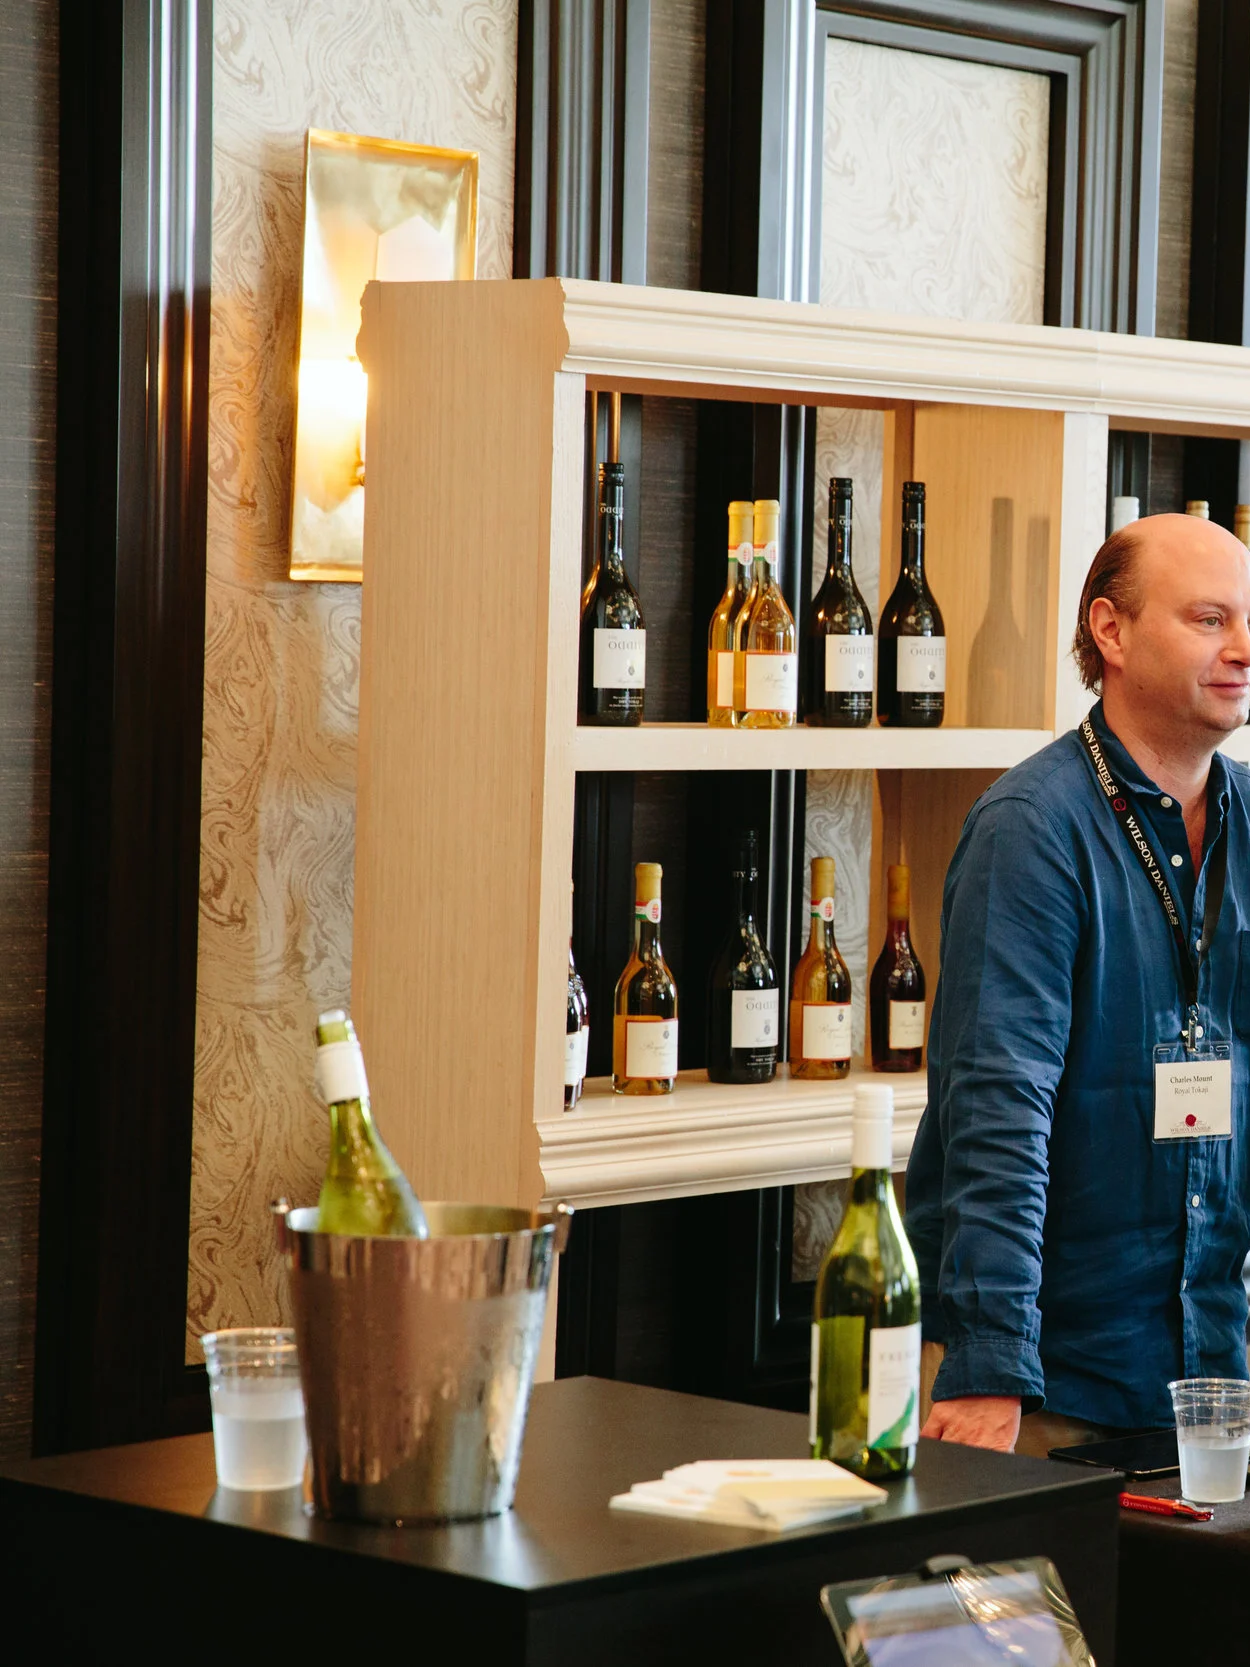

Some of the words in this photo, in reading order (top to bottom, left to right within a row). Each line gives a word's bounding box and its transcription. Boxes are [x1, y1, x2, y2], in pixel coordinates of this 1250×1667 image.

[1082, 714, 1096, 744] LSON
[1090, 743, 1119, 795] DANIELS
[1126, 815, 1156, 868] WILSON
[1151, 869, 1179, 925] DANIELS
[1170, 1076, 1192, 1084] Charles
[1174, 1087, 1191, 1096] Royal
[1191, 1086, 1209, 1094] Tokaji
